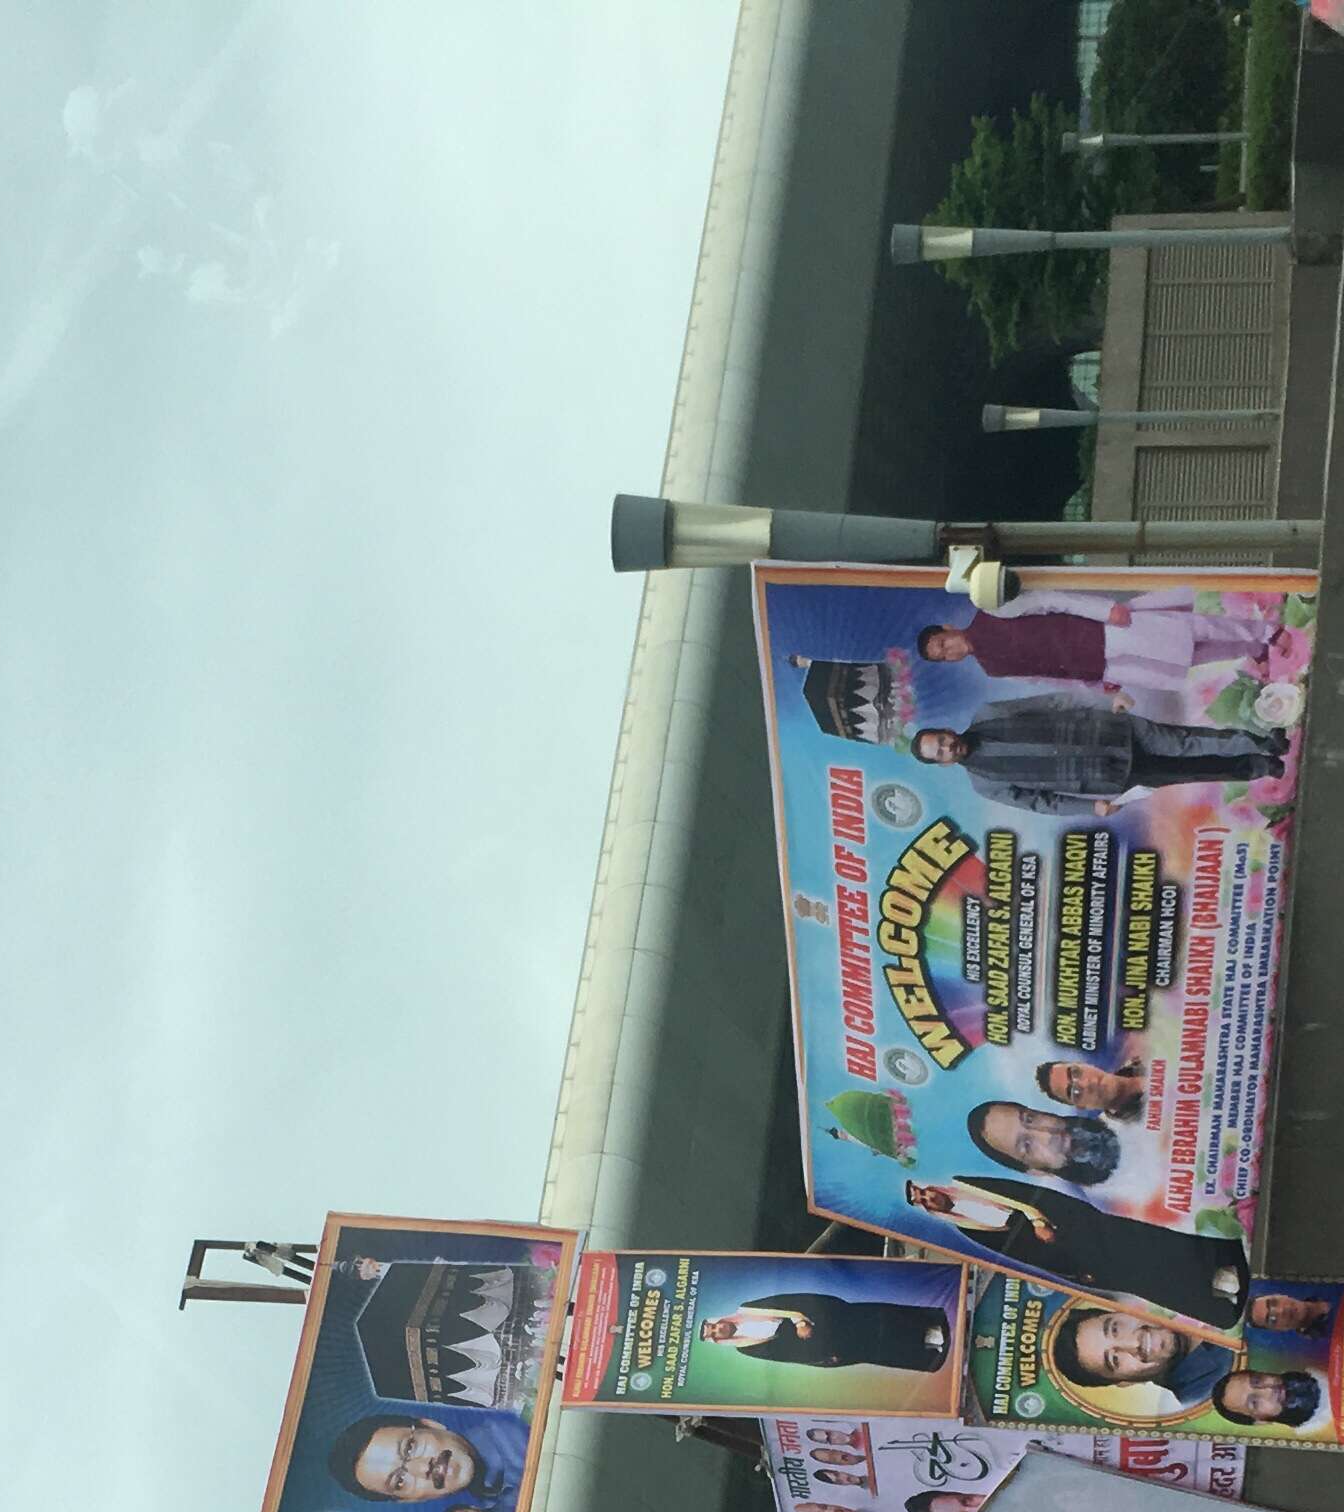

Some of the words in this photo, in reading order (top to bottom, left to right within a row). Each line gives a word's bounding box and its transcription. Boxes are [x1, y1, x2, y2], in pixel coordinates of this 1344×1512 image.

[829, 767, 865, 845] INDIA
[833, 845, 867, 884] OF
[988, 832, 1012, 902] ALGARNI
[1021, 855, 1036, 880] KSA
[1063, 834, 1087, 883] NAQVI
[1091, 832, 1108, 879] AFFAIRS
[1267, 844, 1281, 883] POINT
[1020, 882, 1034, 898] OF
[1131, 851, 1155, 913] SHAIKH
[1160, 885, 1176, 917] HCOI
[988, 904, 1010, 920] S.
[1019, 899, 1034, 950] GENERAL
[1061, 885, 1084, 937] ABBAS
[1088, 880, 1106, 938] MINORITY
[1227, 883, 1244, 956] COMMITTEE
[875, 815, 973, 1069] WELCOME
[966, 898, 980, 963] EXCELLENCY
[988, 922, 1009, 969] ZAFAR
[1088, 938, 1102, 953] OF
[1127, 915, 1150, 953] NABI
[1243, 922, 1256, 960] INDIA
[1258, 887, 1277, 978] EMBARKATION
[836, 885, 874, 1036] COMMITTEE
[967, 964, 979, 982] HIS
[1125, 954, 1148, 990] JINA
[1155, 920, 1173, 987] CHAIRMAN
[1184, 934, 1215, 999] SHAIKH
[1225, 959, 1237, 983] HAJ
[1241, 963, 1252, 979] OF
[988, 970, 1008, 1008] SAAD
[1018, 951, 1032, 1000] COUNSUL
[1058, 938, 1081, 1010] MUKHTAR
[1084, 954, 1101, 1006] MINISTER
[1017, 1001, 1030, 1032] ROYAL
[1123, 992, 1145, 1030] HON.
[1221, 986, 1234, 1020] STATE
[1235, 982, 1251, 1051] COMMITTEE
[987, 1009, 1008, 1045] HON.
[1057, 1010, 1077, 1045] HON.
[1083, 1007, 1097, 1052] CABINET
[1249, 981, 1267, 1071] MAHARASHTRA
[845, 1036, 877, 1082] HAJ
[1176, 1000, 1209, 1097] GULAMNABI
[1213, 1023, 1231, 1111] MAHARASHTRA
[1232, 1054, 1244, 1078] HAJ
[1149, 1058, 1165, 1098] SHAIKH
[1146, 1098, 1162, 1132] FAHIM
[1227, 1080, 1241, 1129] MEMBER
[1239, 1074, 1258, 1165] CO-ORDINATOR
[1171, 1096, 1200, 1168] EBRAHIM
[1207, 1114, 1222, 1176] CHAIRMAN
[1167, 1167, 1193, 1214] ALHAJ
[1205, 1178, 1216, 1196] EX.
[1236, 1167, 1248, 1198] CHIEF
[631, 1263, 644, 1291] INDIA
[675, 1259, 690, 1300] ALGARNI
[690, 1288, 696, 1296] OF
[1004, 1279, 1020, 1302] INDI
[629, 1294, 640, 1308] OF
[673, 1303, 683, 1311] S.
[1003, 1305, 1018, 1320] OF
[619, 1310, 637, 1373] COMMITTEE
[635, 1290, 660, 1368] WELCOMES
[669, 1314, 682, 1344] ZAFAR
[1017, 1300, 1042, 1387] WELCOMES
[665, 1347, 678, 1372] SAAD
[994, 1323, 1016, 1391] COMMITTEE
[615, 1377, 627, 1395] HAJ
[661, 1375, 674, 1398] HON.
[993, 1394, 1009, 1415] HAJ
[776, 1419, 801, 1454] जनता
[778, 1457, 811, 1499] भारतीय
